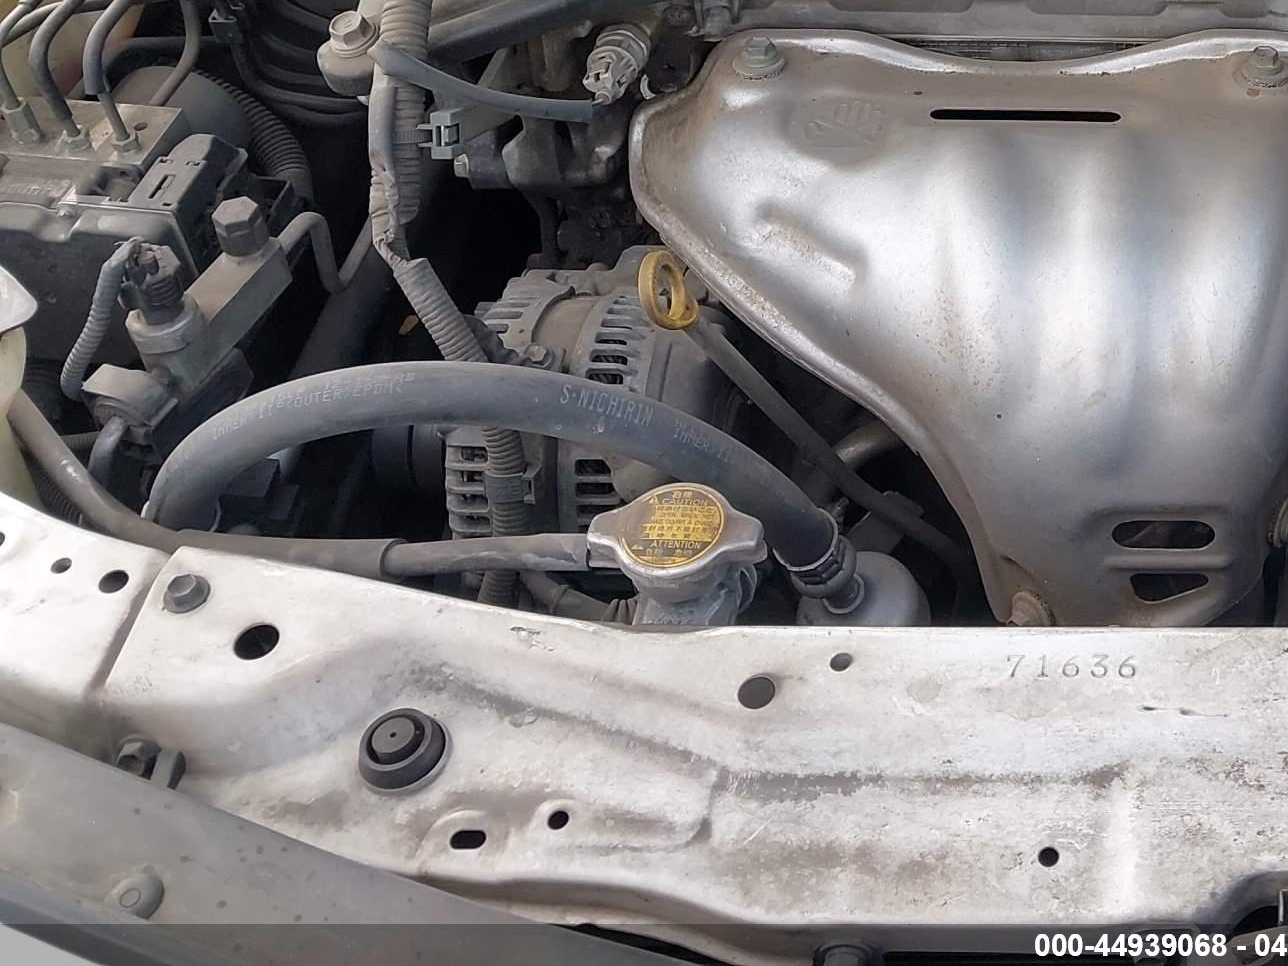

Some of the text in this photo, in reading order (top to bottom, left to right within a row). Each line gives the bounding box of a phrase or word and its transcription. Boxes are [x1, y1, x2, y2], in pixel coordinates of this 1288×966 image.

[662, 498, 708, 506] CAUTION
[650, 540, 701, 549] ATTENTION
[1006, 654, 1136, 678] 71636
